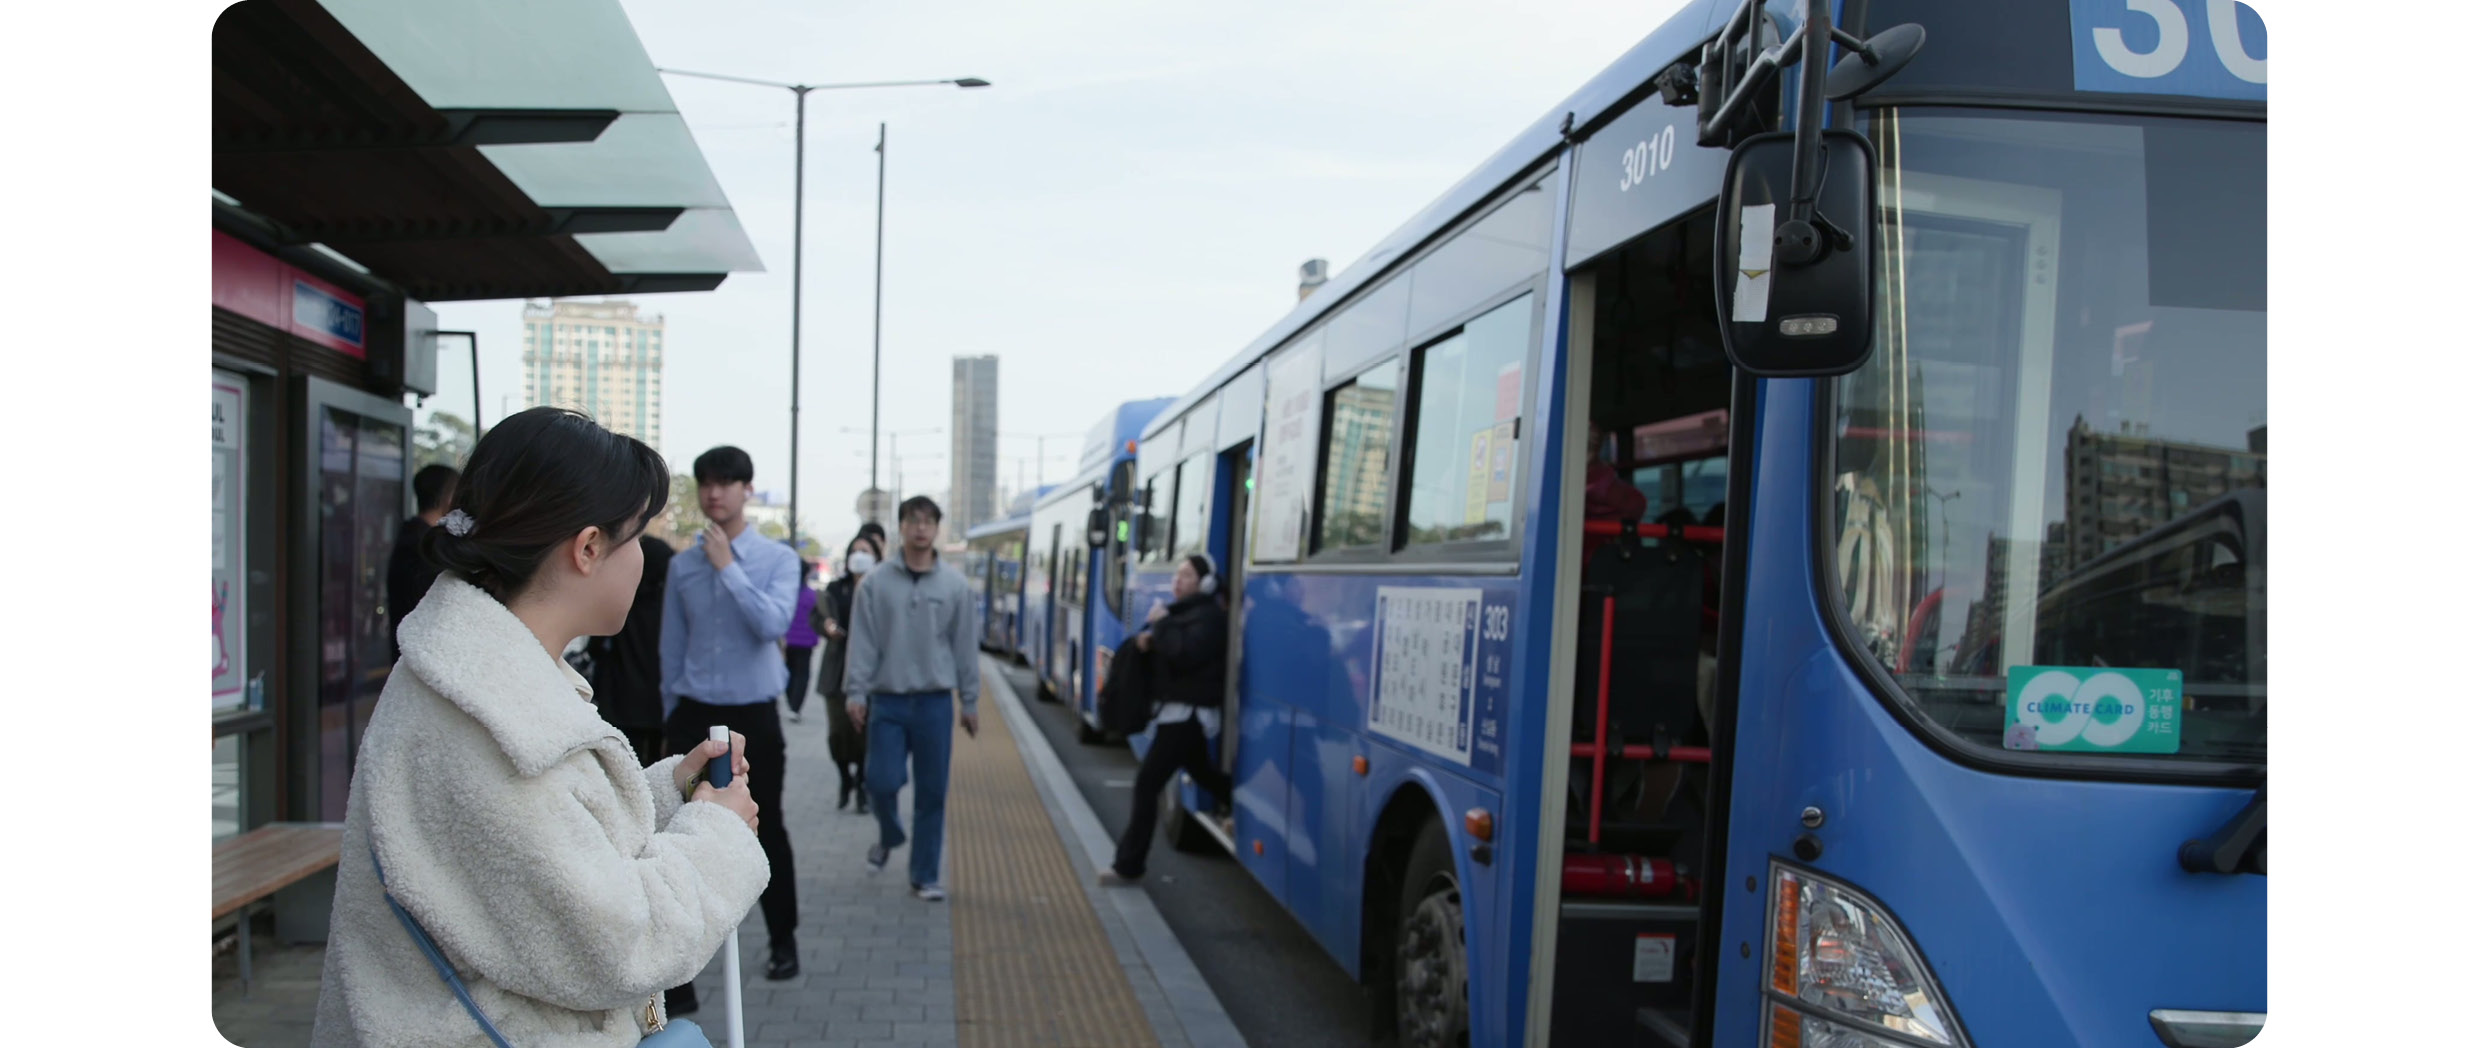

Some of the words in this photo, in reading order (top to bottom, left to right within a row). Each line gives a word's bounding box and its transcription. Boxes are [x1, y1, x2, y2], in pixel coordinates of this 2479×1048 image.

[1620, 124, 1675, 192] 3010
[1483, 605, 1509, 642] 303
[2149, 688, 2174, 703] 기후
[2027, 702, 2090, 714] CLIMATE
[2095, 704, 2135, 715] CARD
[2147, 705, 2174, 720] 동행
[2147, 722, 2172, 735] 카드
